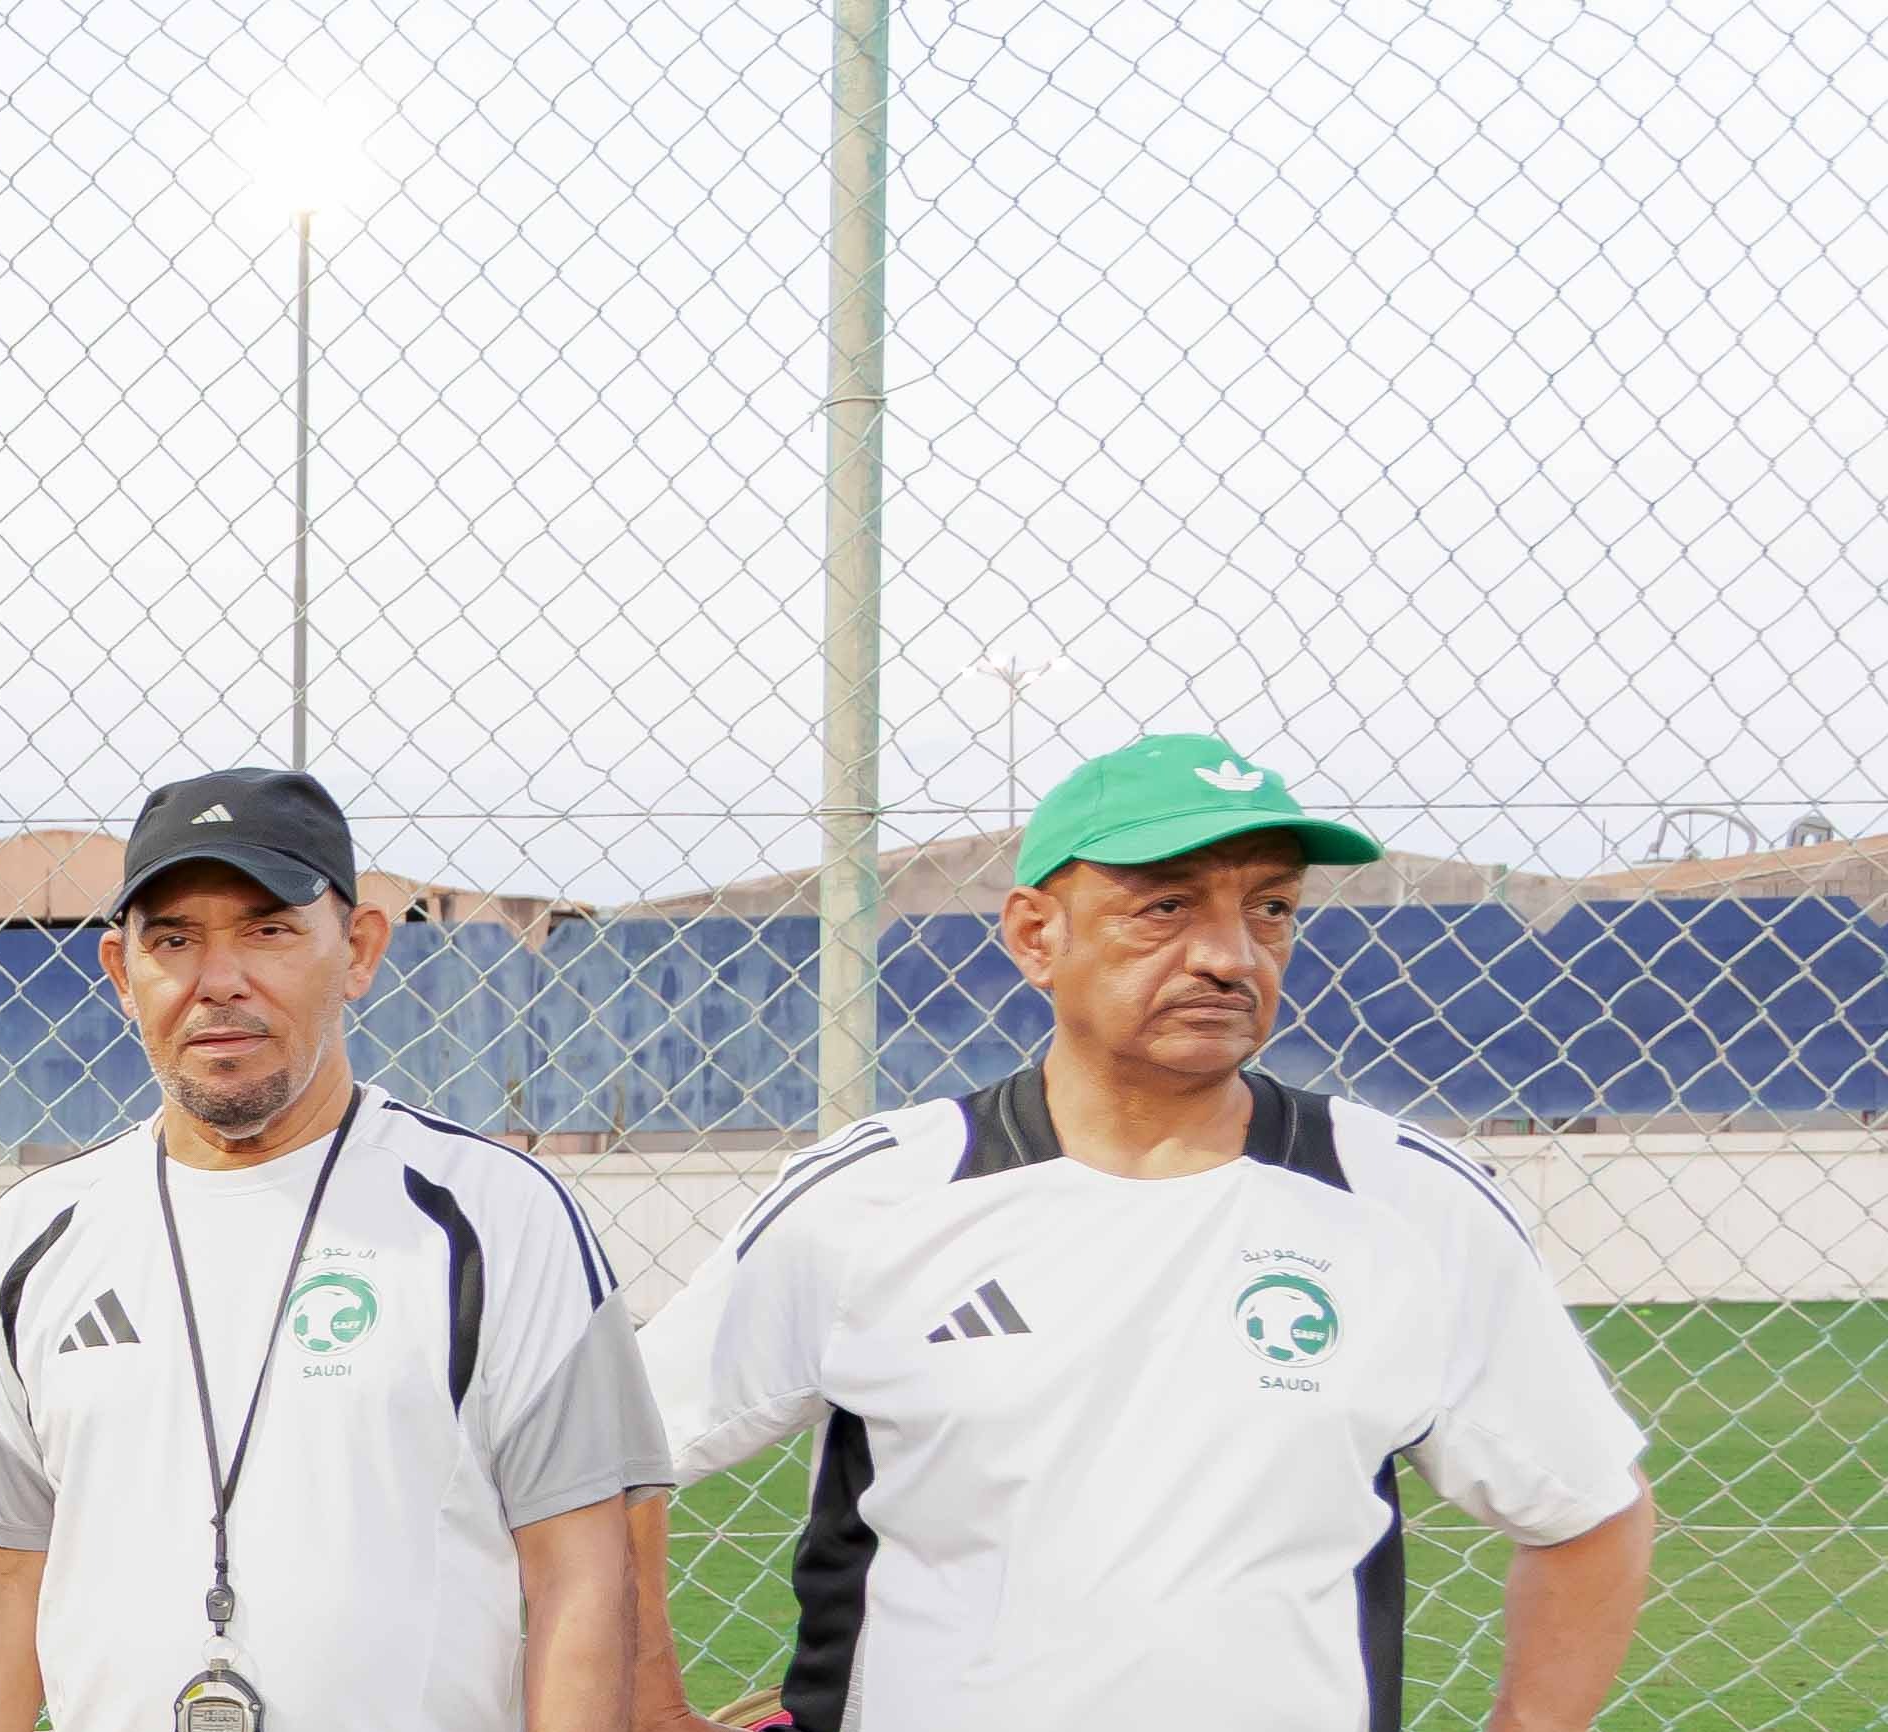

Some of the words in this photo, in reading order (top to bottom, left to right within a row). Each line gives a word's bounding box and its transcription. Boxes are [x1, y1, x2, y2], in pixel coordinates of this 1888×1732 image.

[1241, 1248, 1332, 1273] السعودية
[303, 1364, 352, 1378] SAUDI
[1259, 1375, 1320, 1392] SAUDI
